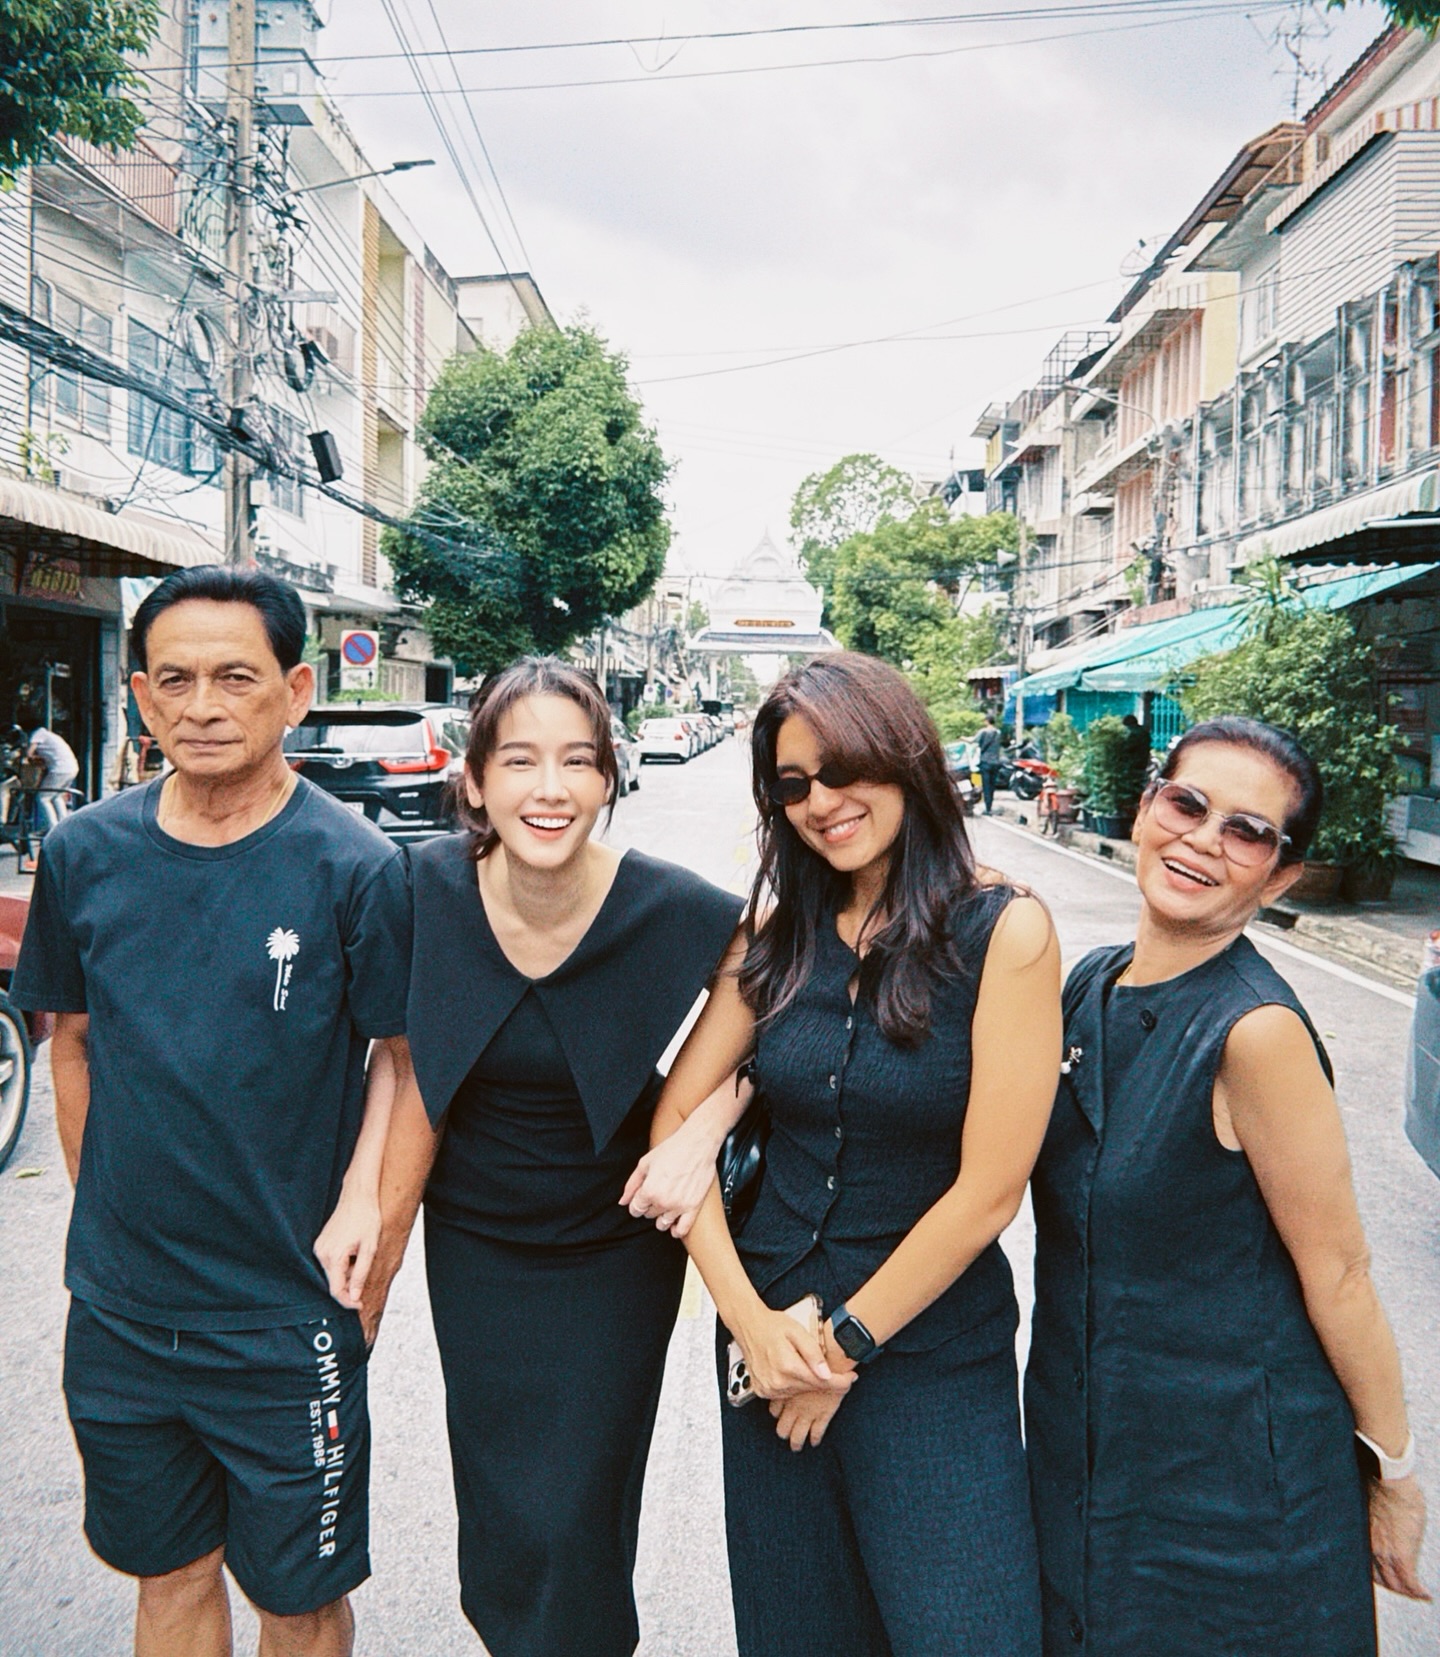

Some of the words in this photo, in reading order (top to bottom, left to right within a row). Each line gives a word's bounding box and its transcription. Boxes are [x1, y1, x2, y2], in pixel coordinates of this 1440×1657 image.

[313, 1318, 342, 1405] OMMY
[309, 1399, 322, 1433] EST.
[311, 1433, 326, 1467] 1985
[319, 1443, 345, 1558] HILFIGER
